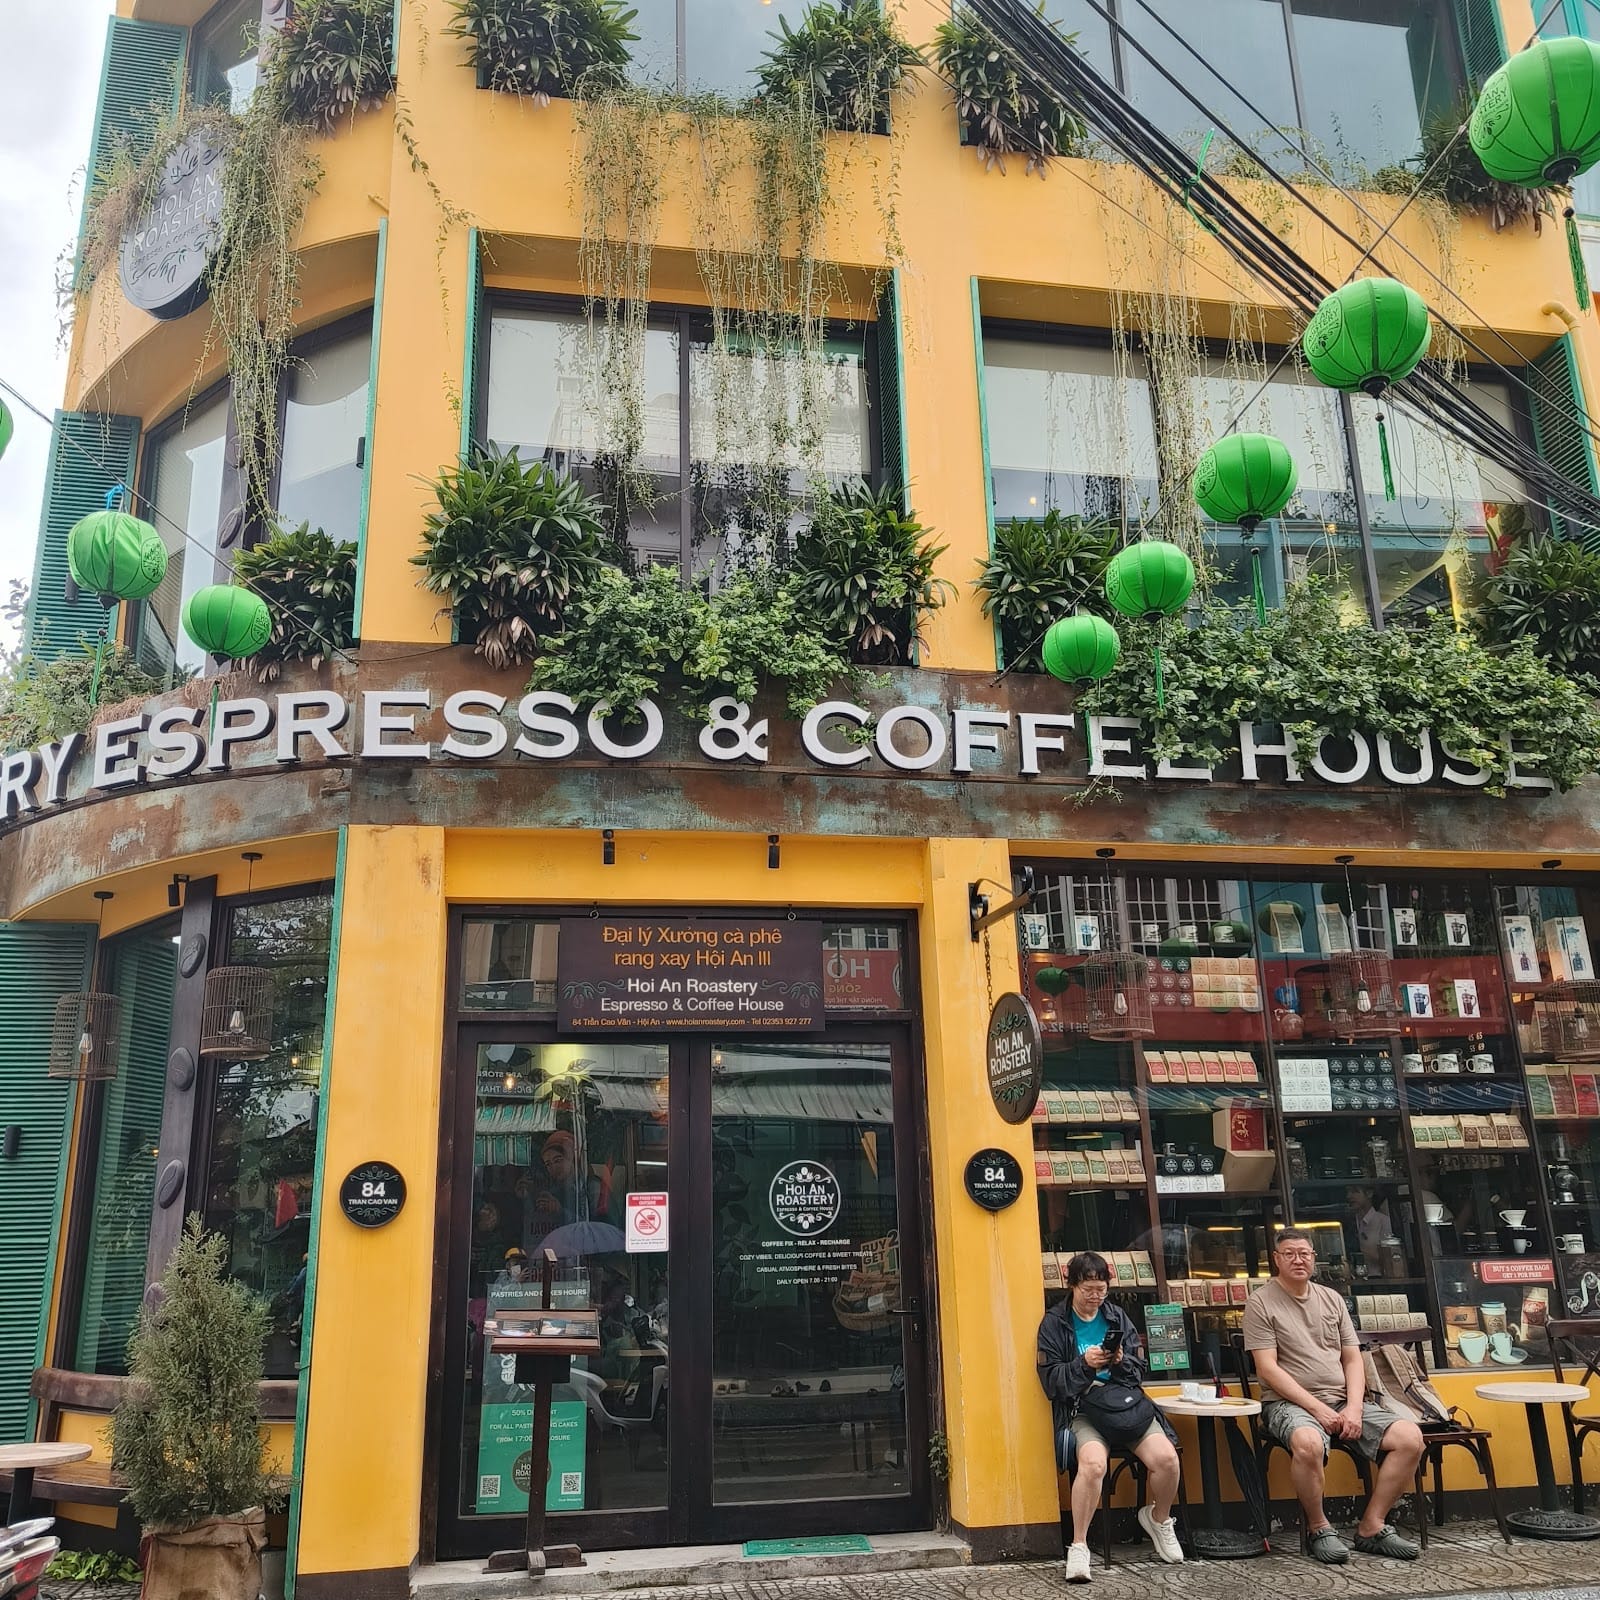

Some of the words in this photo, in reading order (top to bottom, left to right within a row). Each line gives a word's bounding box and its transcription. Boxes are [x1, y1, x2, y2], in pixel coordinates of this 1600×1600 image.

[150, 189, 184, 224] HOI
[189, 168, 217, 202] AN
[132, 190, 218, 257] ROASTER
[91, 689, 663, 790] ESPRESSO
[698, 695, 769, 761] &
[603, 927, 632, 946] Đại
[638, 927, 652, 946] lý
[658, 928, 719, 947] Xưởng
[723, 927, 745, 944] cà
[749, 927, 782, 947] phê
[614, 953, 654, 970] rang
[660, 954, 691, 970] xay
[696, 950, 725, 969] Hội
[731, 951, 753, 966] An
[759, 951, 771, 966] III
[628, 978, 653, 993] Hoi
[659, 978, 682, 993] An
[688, 978, 758, 997] Roastery
[602, 998, 668, 1014] Espresso
[672, 998, 683, 1011] &
[687, 998, 734, 1011] Coffee
[739, 998, 784, 1011] House
[601, 1018, 615, 1026] Cao
[650, 1018, 660, 1026] An
[666, 1018, 745, 1027] www.hoianroastery.com
[995, 1038, 1010, 1057] HOI
[1012, 1032, 1024, 1051] AN
[991, 1043, 1032, 1076] ROASTERY
[984, 1168, 1005, 1182] 84
[362, 1182, 386, 1197] 84
[786, 1184, 805, 1195] HOI
[810, 1184, 825, 1195] AN
[776, 1193, 835, 1206] ROASTERY
[491, 1290, 524, 1298] PASTRIES
[564, 1288, 587, 1296] HOURS
